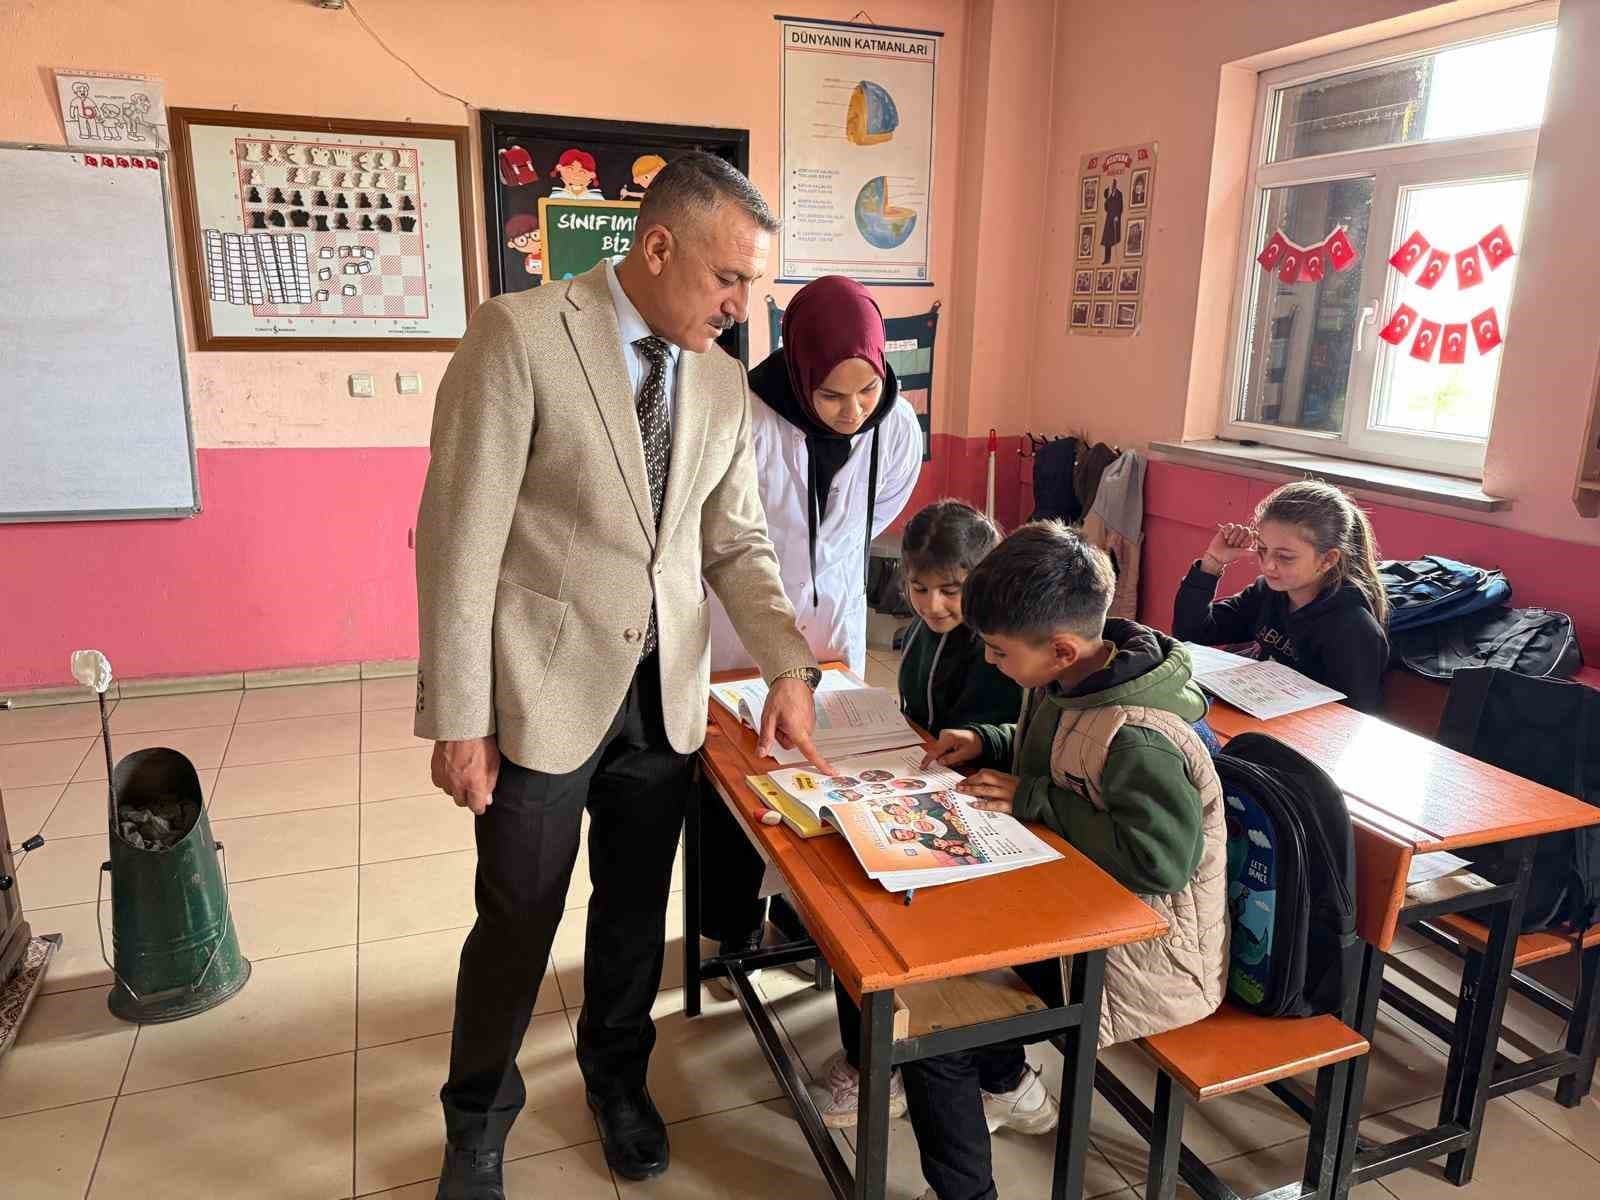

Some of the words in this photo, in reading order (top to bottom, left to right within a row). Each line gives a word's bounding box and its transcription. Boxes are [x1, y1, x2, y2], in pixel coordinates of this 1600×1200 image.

[791, 31, 851, 48] DÜNYANIN
[854, 38, 928, 56] KATMANLARI
[601, 232, 631, 253] BİZ
